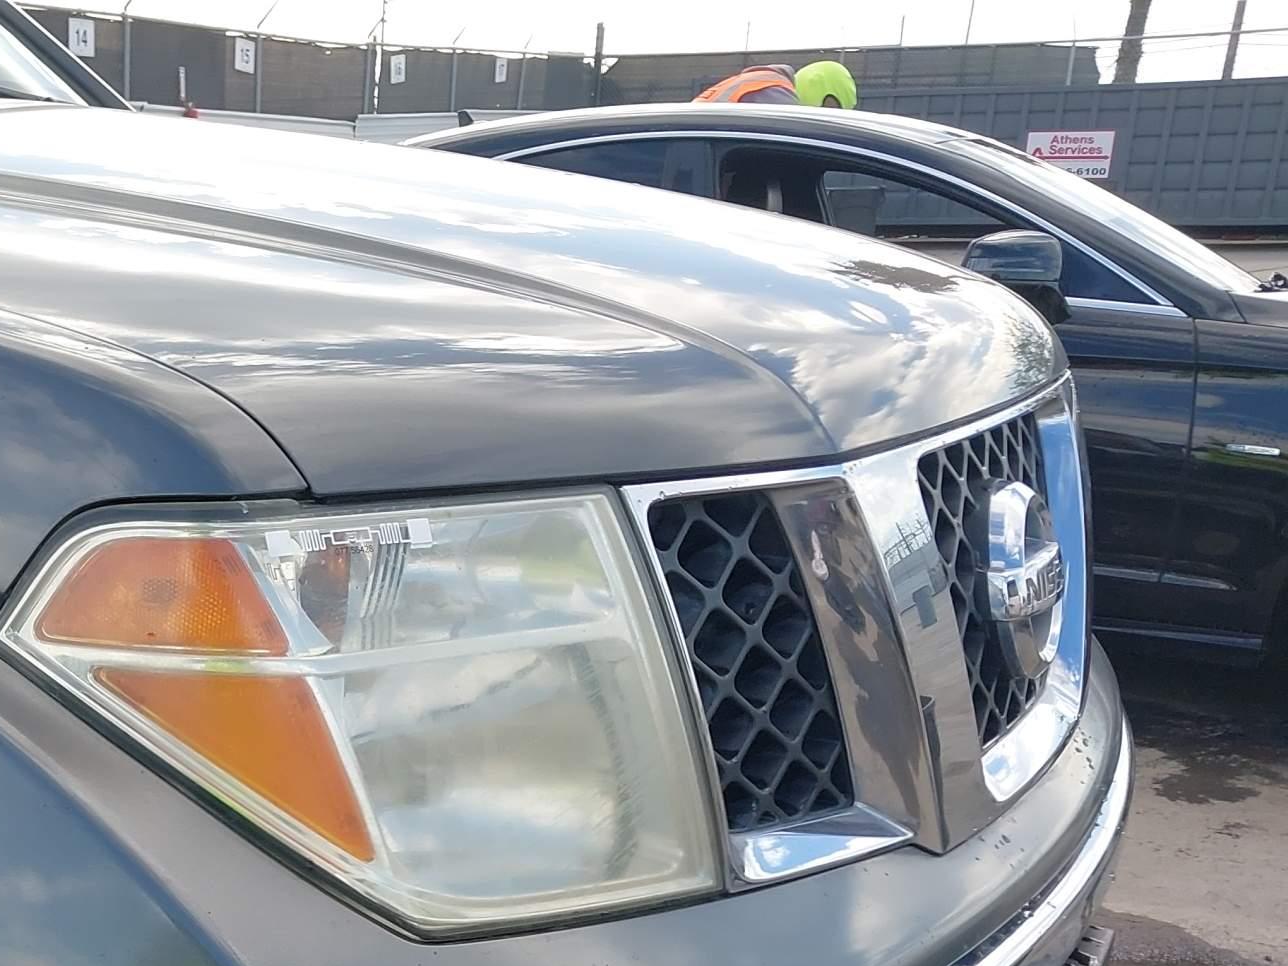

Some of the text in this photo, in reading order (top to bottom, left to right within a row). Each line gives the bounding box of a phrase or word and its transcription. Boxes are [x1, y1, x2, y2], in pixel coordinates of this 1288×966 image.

[75, 29, 88, 47] 14
[240, 48, 251, 65] 15
[1050, 135, 1095, 145] Athens
[1048, 145, 1103, 155] Services
